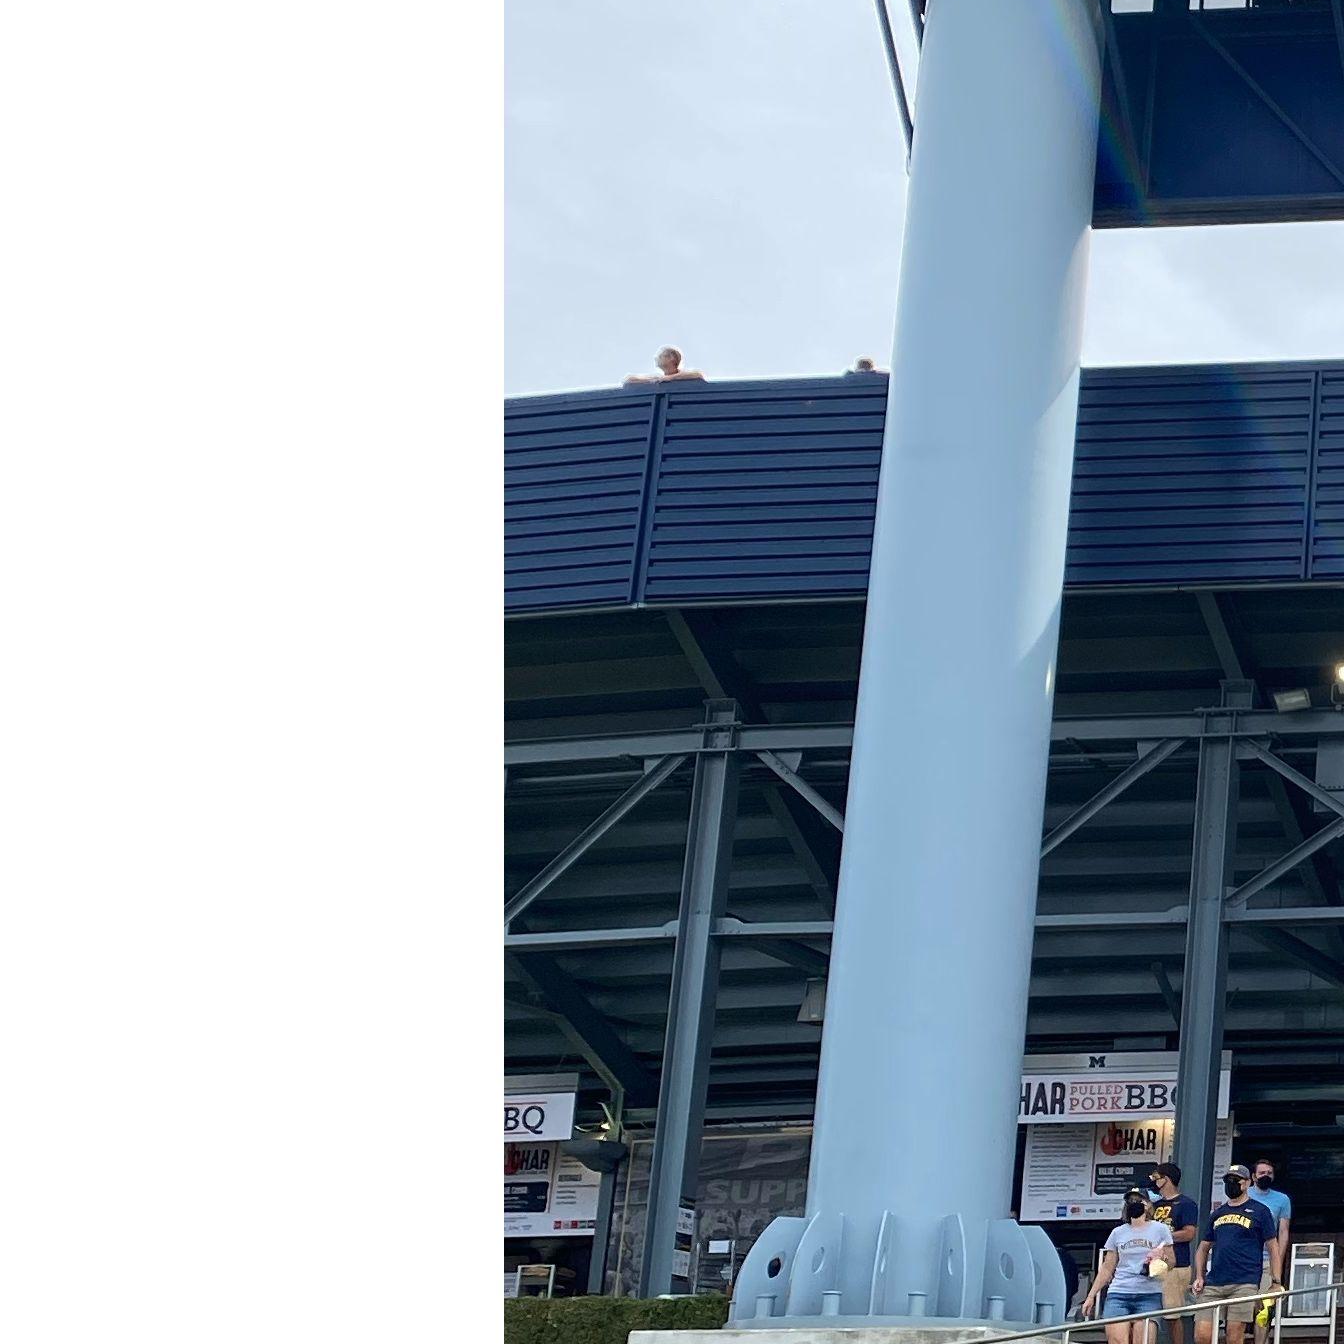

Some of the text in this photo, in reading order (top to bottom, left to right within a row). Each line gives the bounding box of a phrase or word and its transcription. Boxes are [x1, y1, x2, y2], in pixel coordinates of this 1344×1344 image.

[1088, 1055, 1106, 1069] M
[1019, 1081, 1178, 1117] HAR PULLED BB
[1069, 1096, 1123, 1111] PORK
[504, 1105, 545, 1135] BQ
[706, 1178, 807, 1204] SUPP
